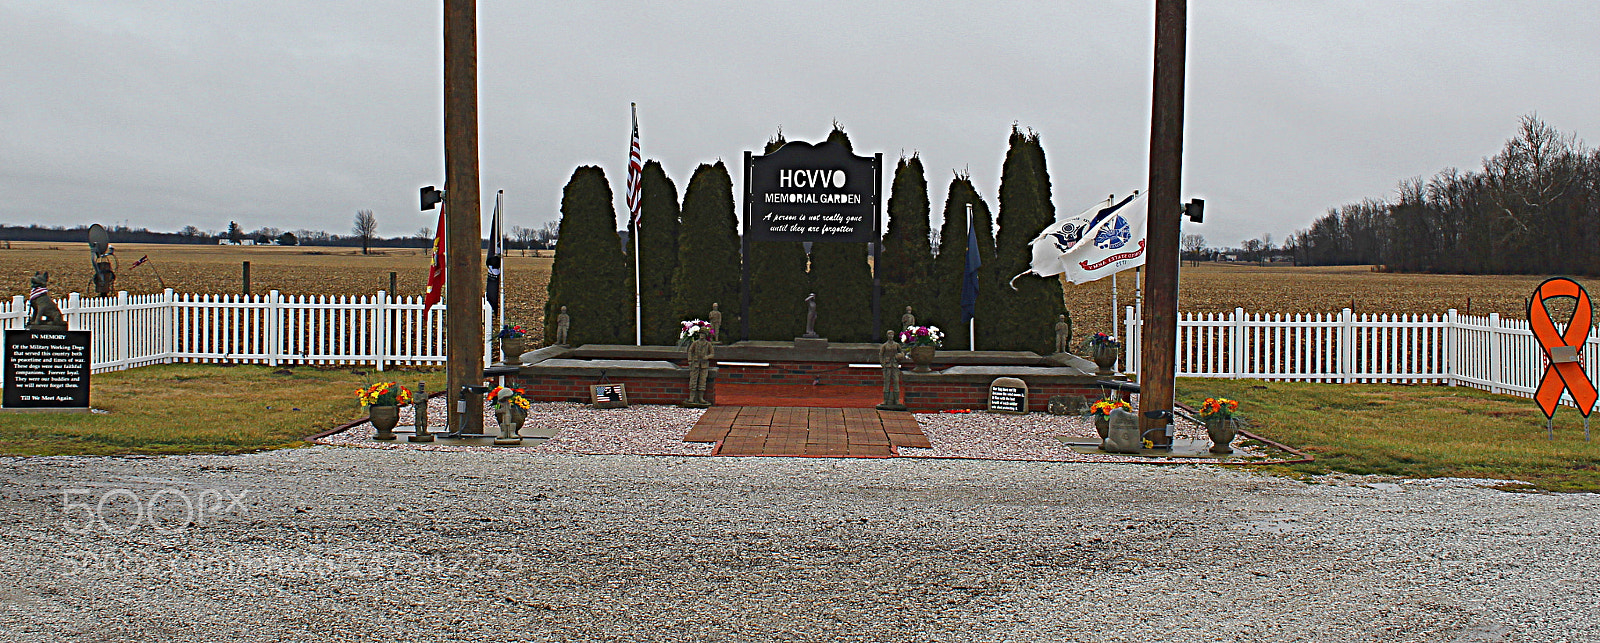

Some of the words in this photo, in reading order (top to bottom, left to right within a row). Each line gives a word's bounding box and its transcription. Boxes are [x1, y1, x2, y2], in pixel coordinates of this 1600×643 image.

[780, 169, 846, 188] HCVVO
[765, 193, 818, 204] MEMORIAL
[820, 194, 860, 204] GARDEN
[763, 212, 772, 221] A
[823, 213, 843, 223] really
[846, 215, 862, 224] gone
[770, 224, 788, 232] until
[790, 223, 805, 234] they
[821, 224, 853, 234] forgotten
